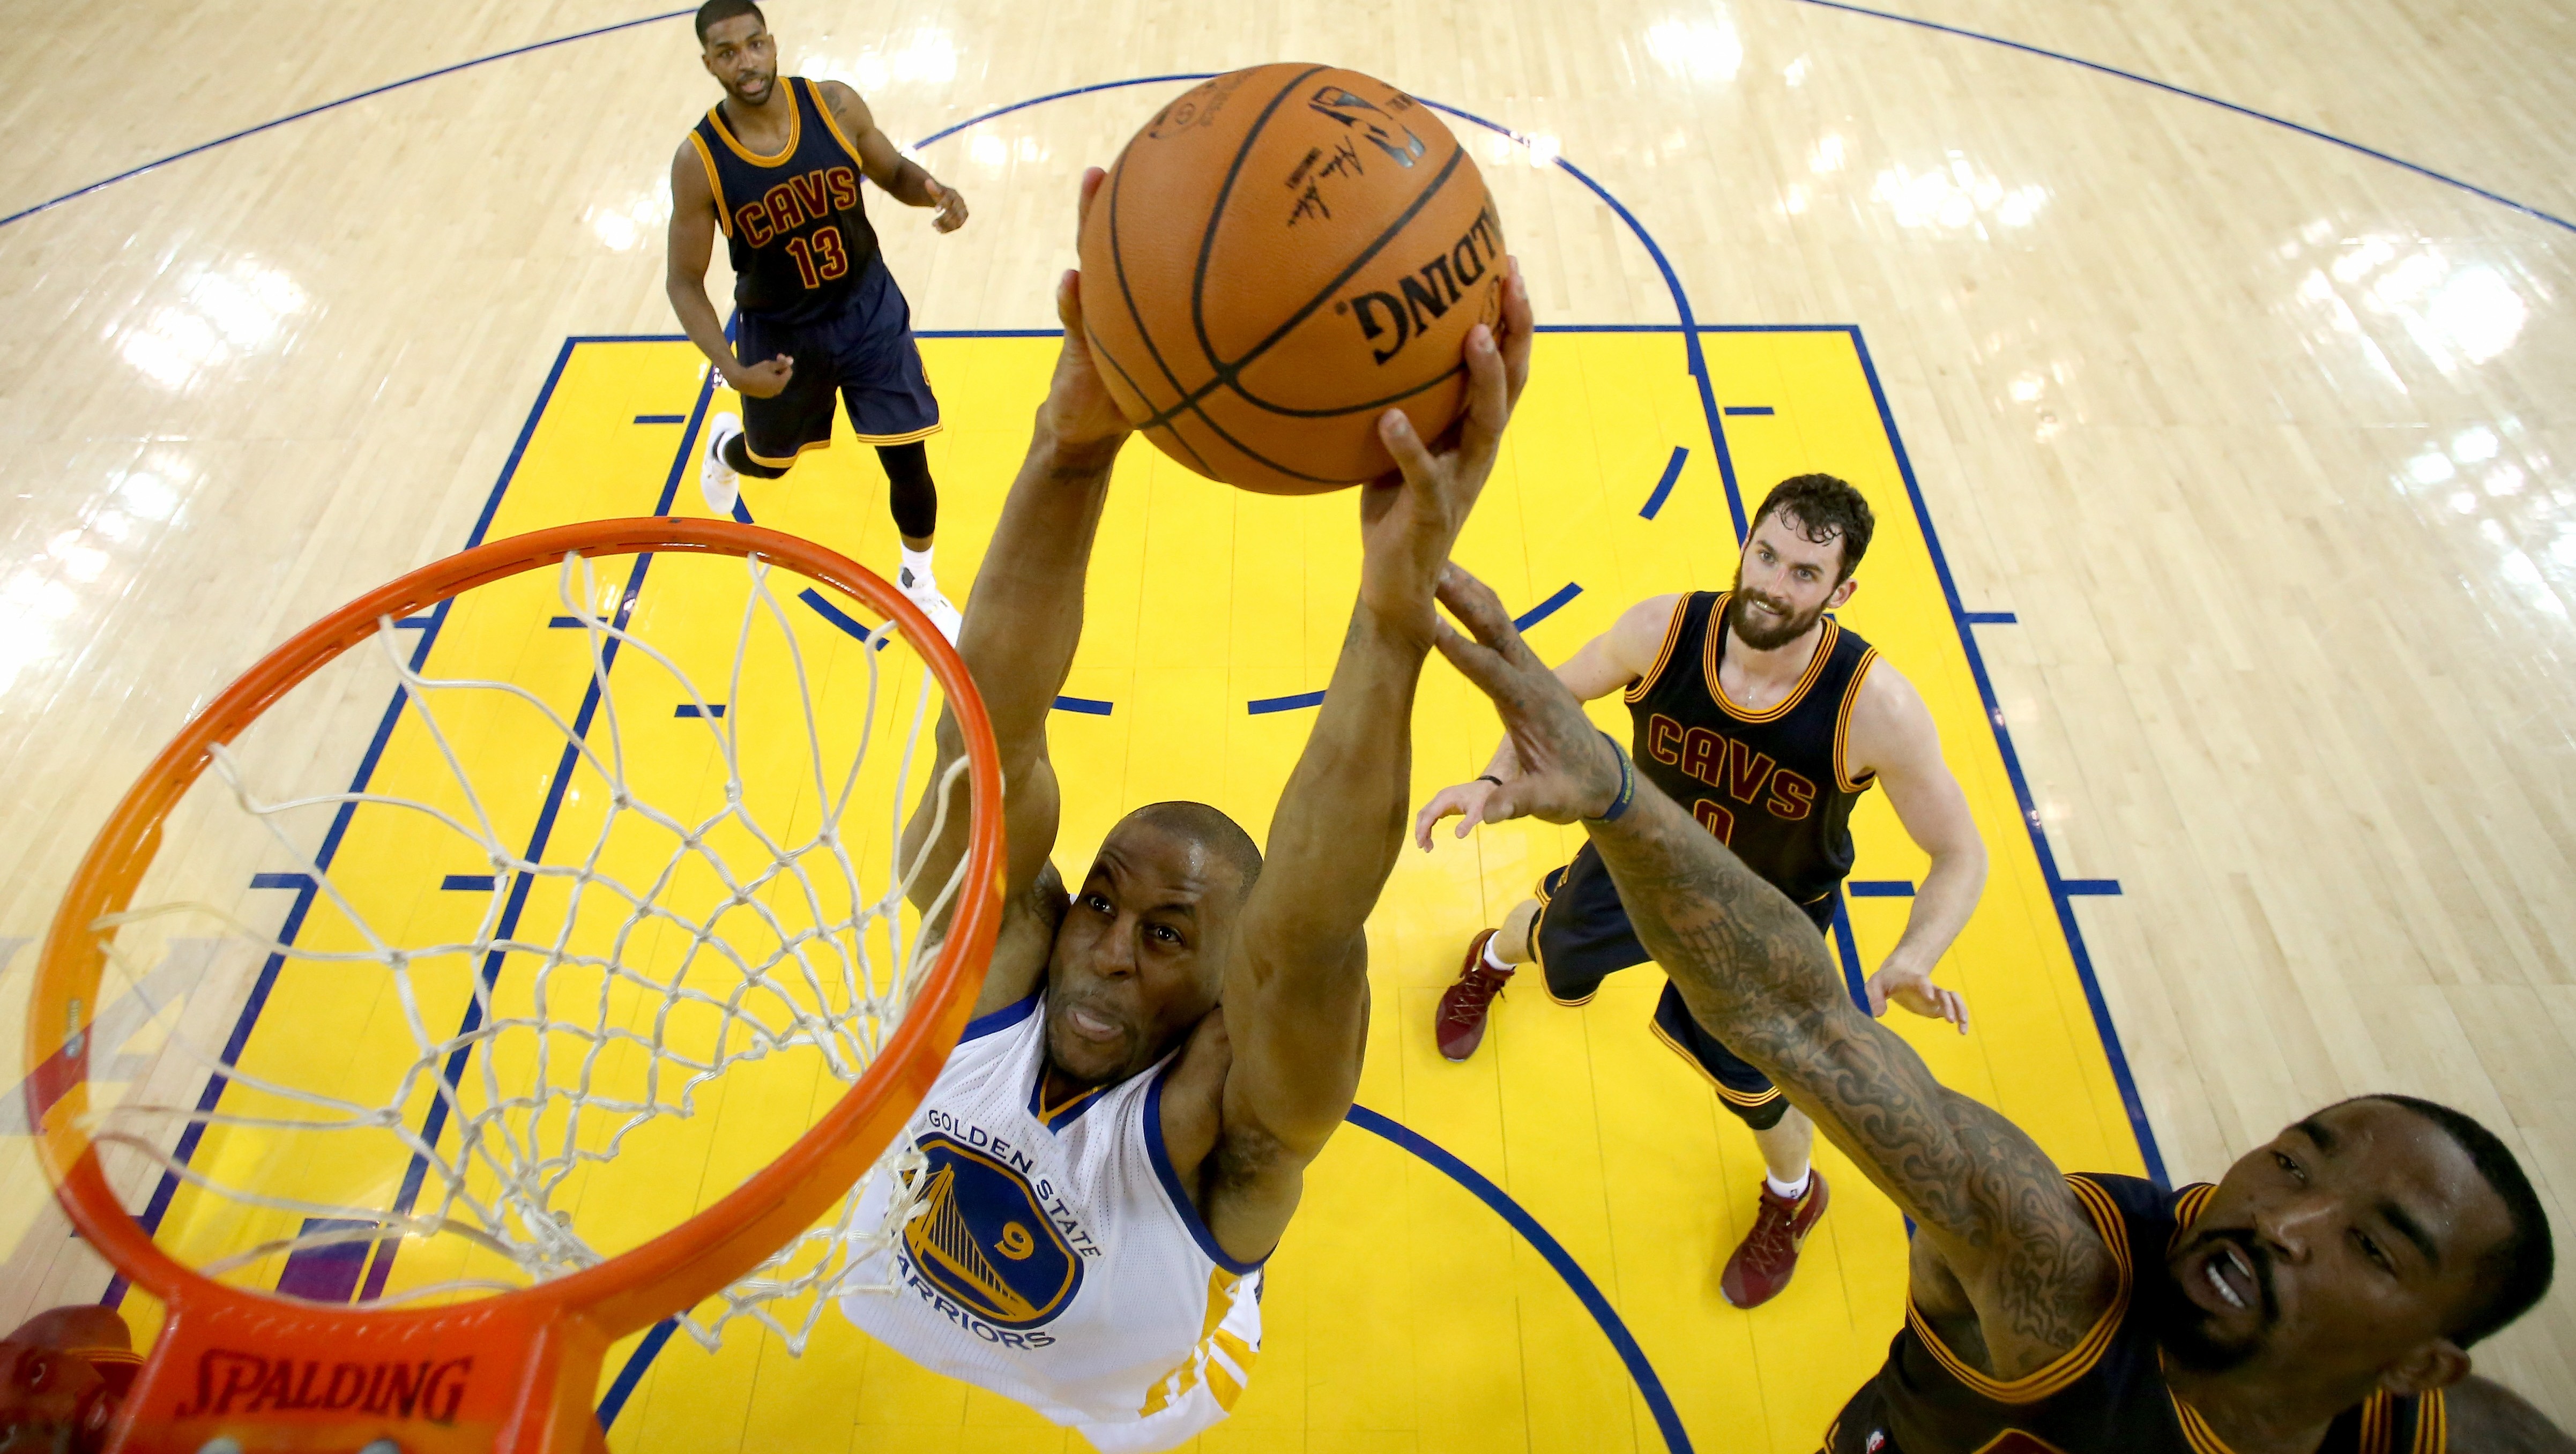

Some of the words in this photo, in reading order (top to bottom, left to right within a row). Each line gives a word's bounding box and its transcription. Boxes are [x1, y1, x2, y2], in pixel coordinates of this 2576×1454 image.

[735, 166, 857, 249] CAVS
[785, 226, 848, 289] 13
[1648, 713, 1816, 821] CAVS
[928, 1109, 1033, 1174] GOLDEN
[1036, 1179, 1101, 1258] STATE
[994, 1221, 1034, 1260] 9
[892, 1235, 1056, 1351] ARRIORS
[174, 1347, 474, 1428] SPALDING
